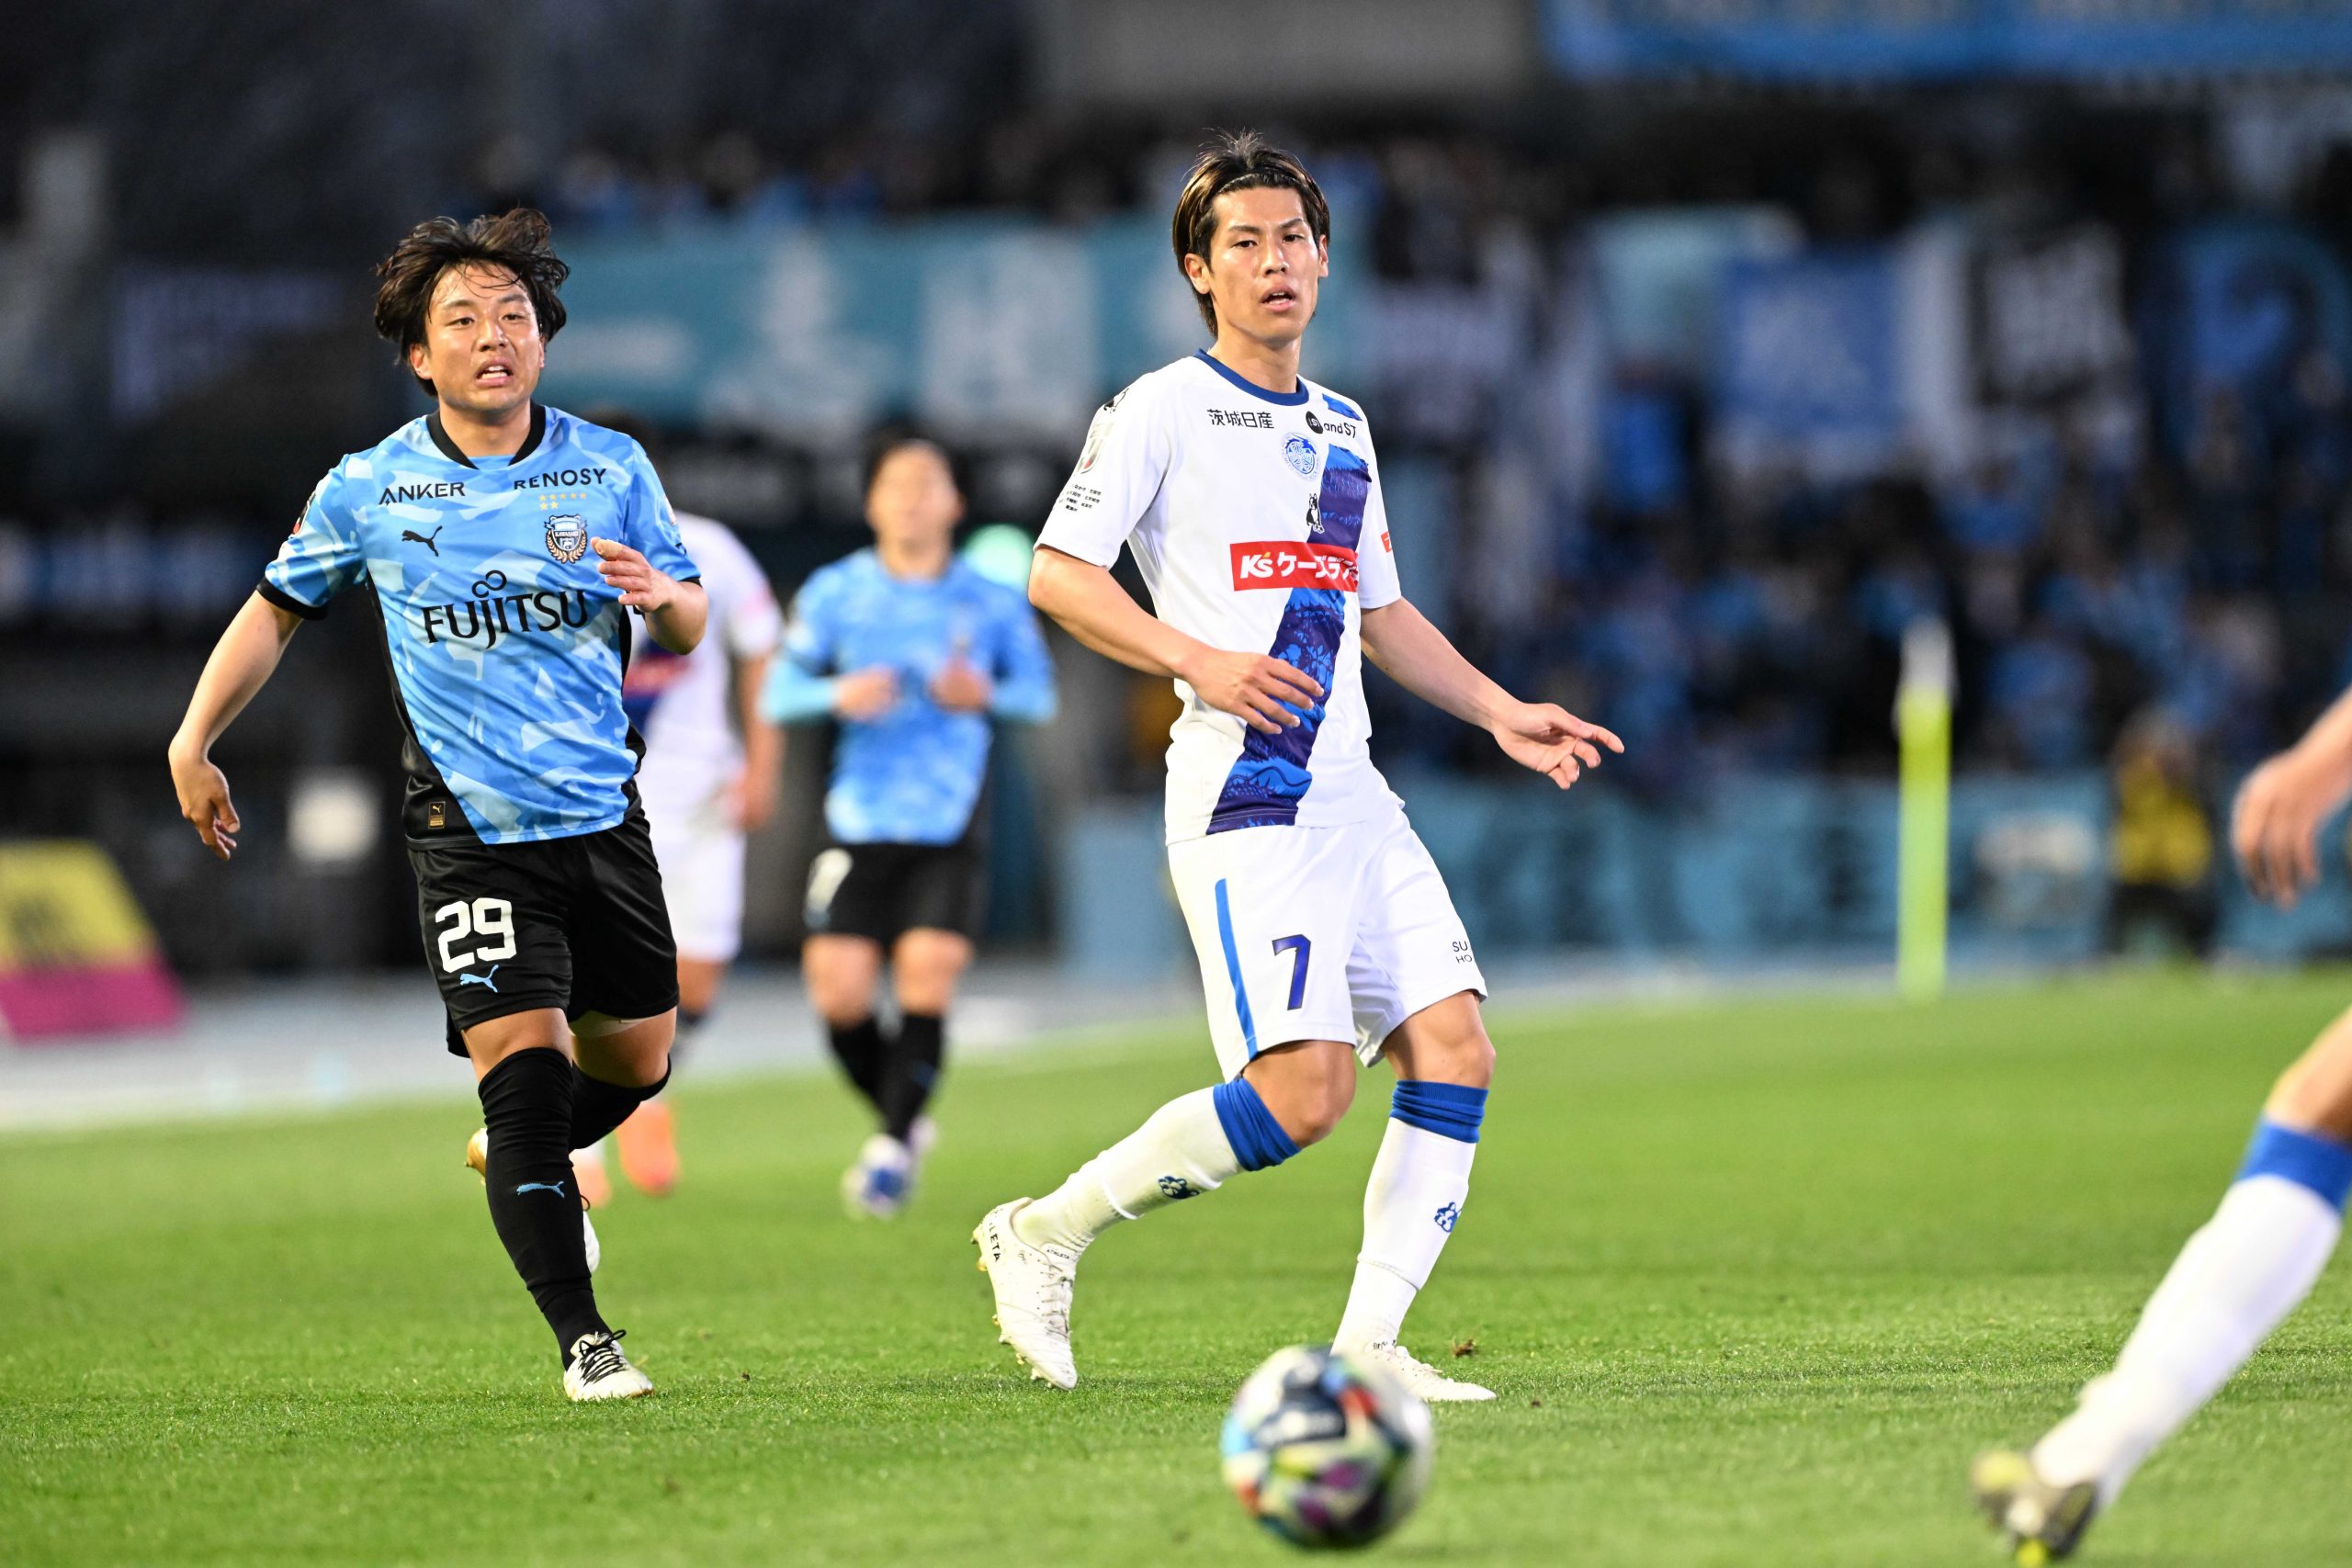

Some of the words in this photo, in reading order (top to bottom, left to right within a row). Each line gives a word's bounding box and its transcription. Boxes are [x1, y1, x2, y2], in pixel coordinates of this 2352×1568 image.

[1207, 409, 1274, 429] 茨城日産
[1324, 423, 1343, 434] and
[1344, 423, 1357, 438] ST
[514, 468, 607, 491] RENOSY
[379, 481, 466, 506] ANKER
[421, 589, 588, 649] FUJITSU
[435, 897, 517, 974] 29
[1272, 934, 1311, 1010] 7
